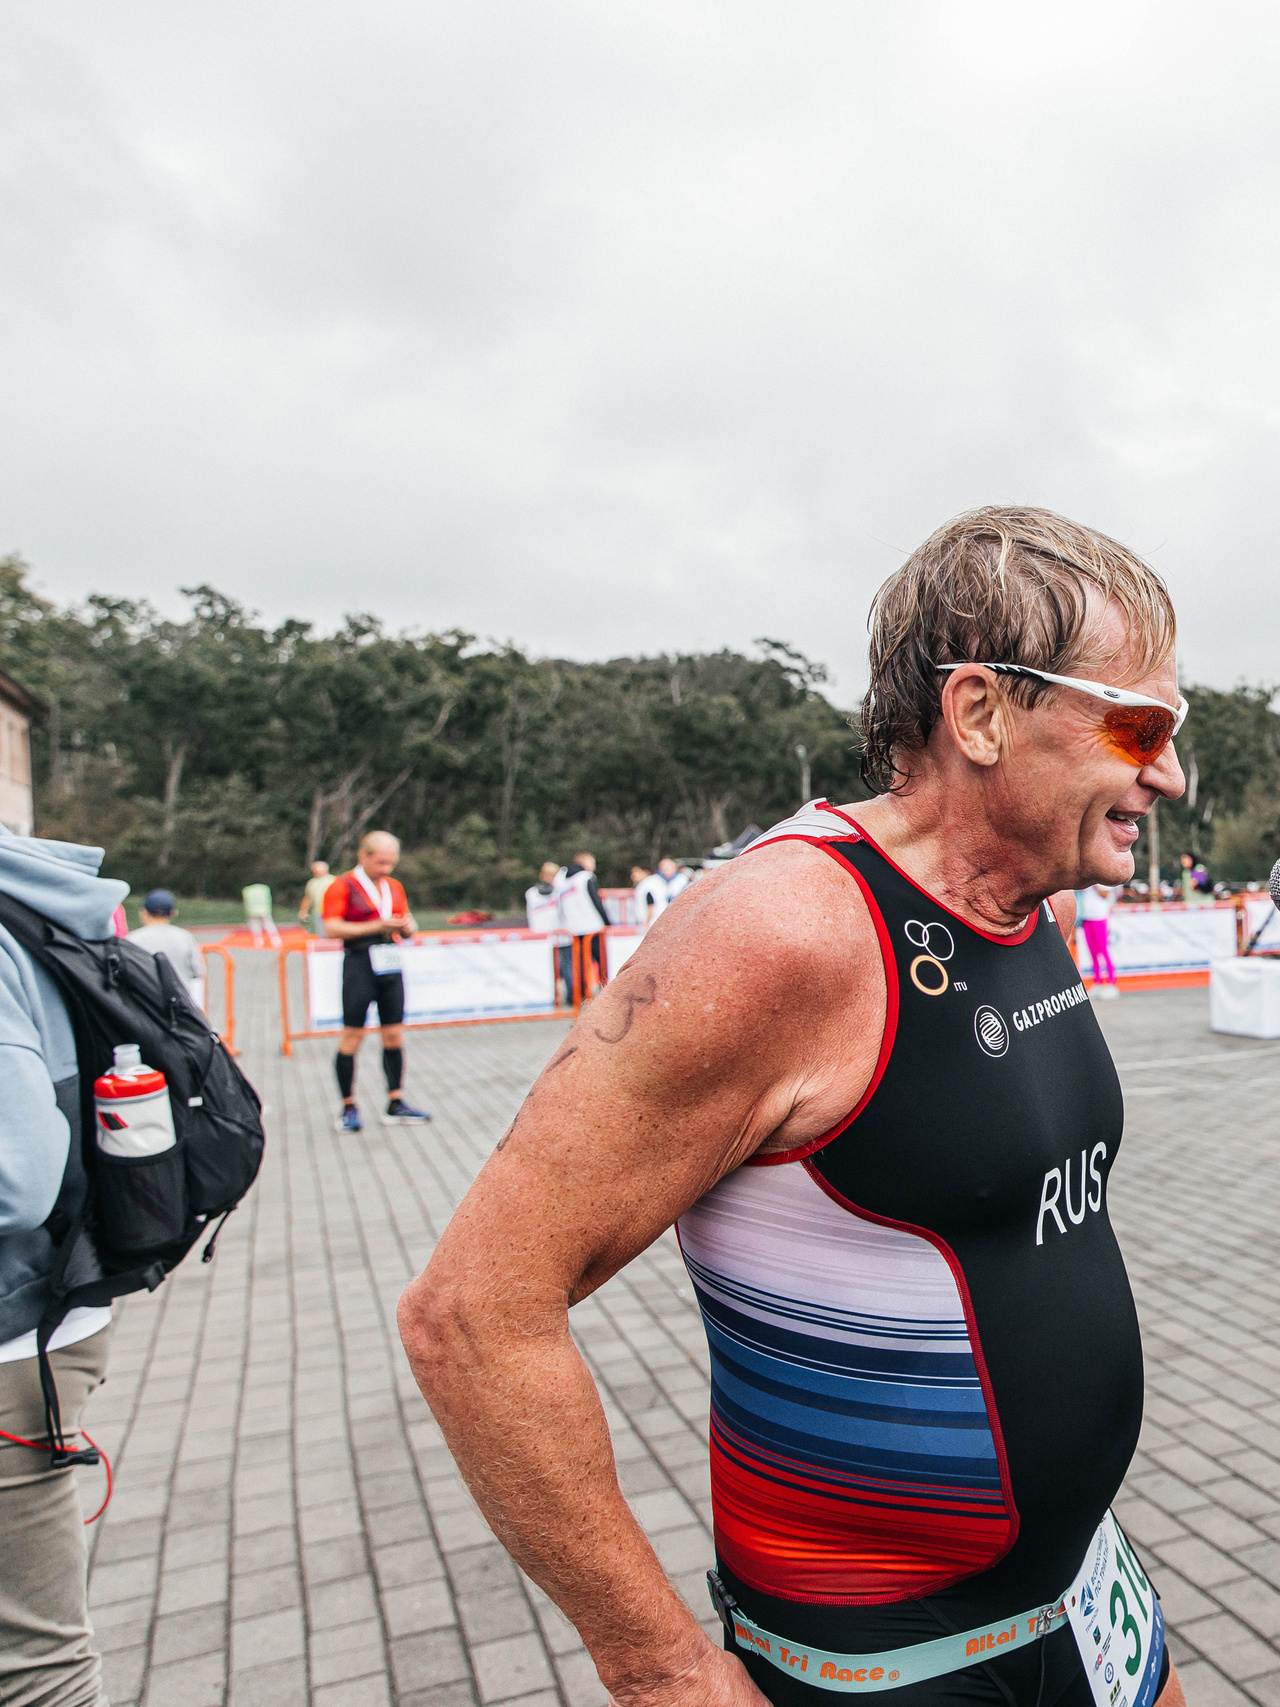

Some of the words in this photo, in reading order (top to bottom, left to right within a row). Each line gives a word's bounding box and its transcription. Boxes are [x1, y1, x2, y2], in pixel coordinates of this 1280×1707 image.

[953, 981, 968, 992] ITU
[1036, 1141, 1107, 1246] RUS
[735, 1622, 771, 1654] Altai
[779, 1646, 808, 1672] Tri
[965, 1624, 1017, 1657] Altai
